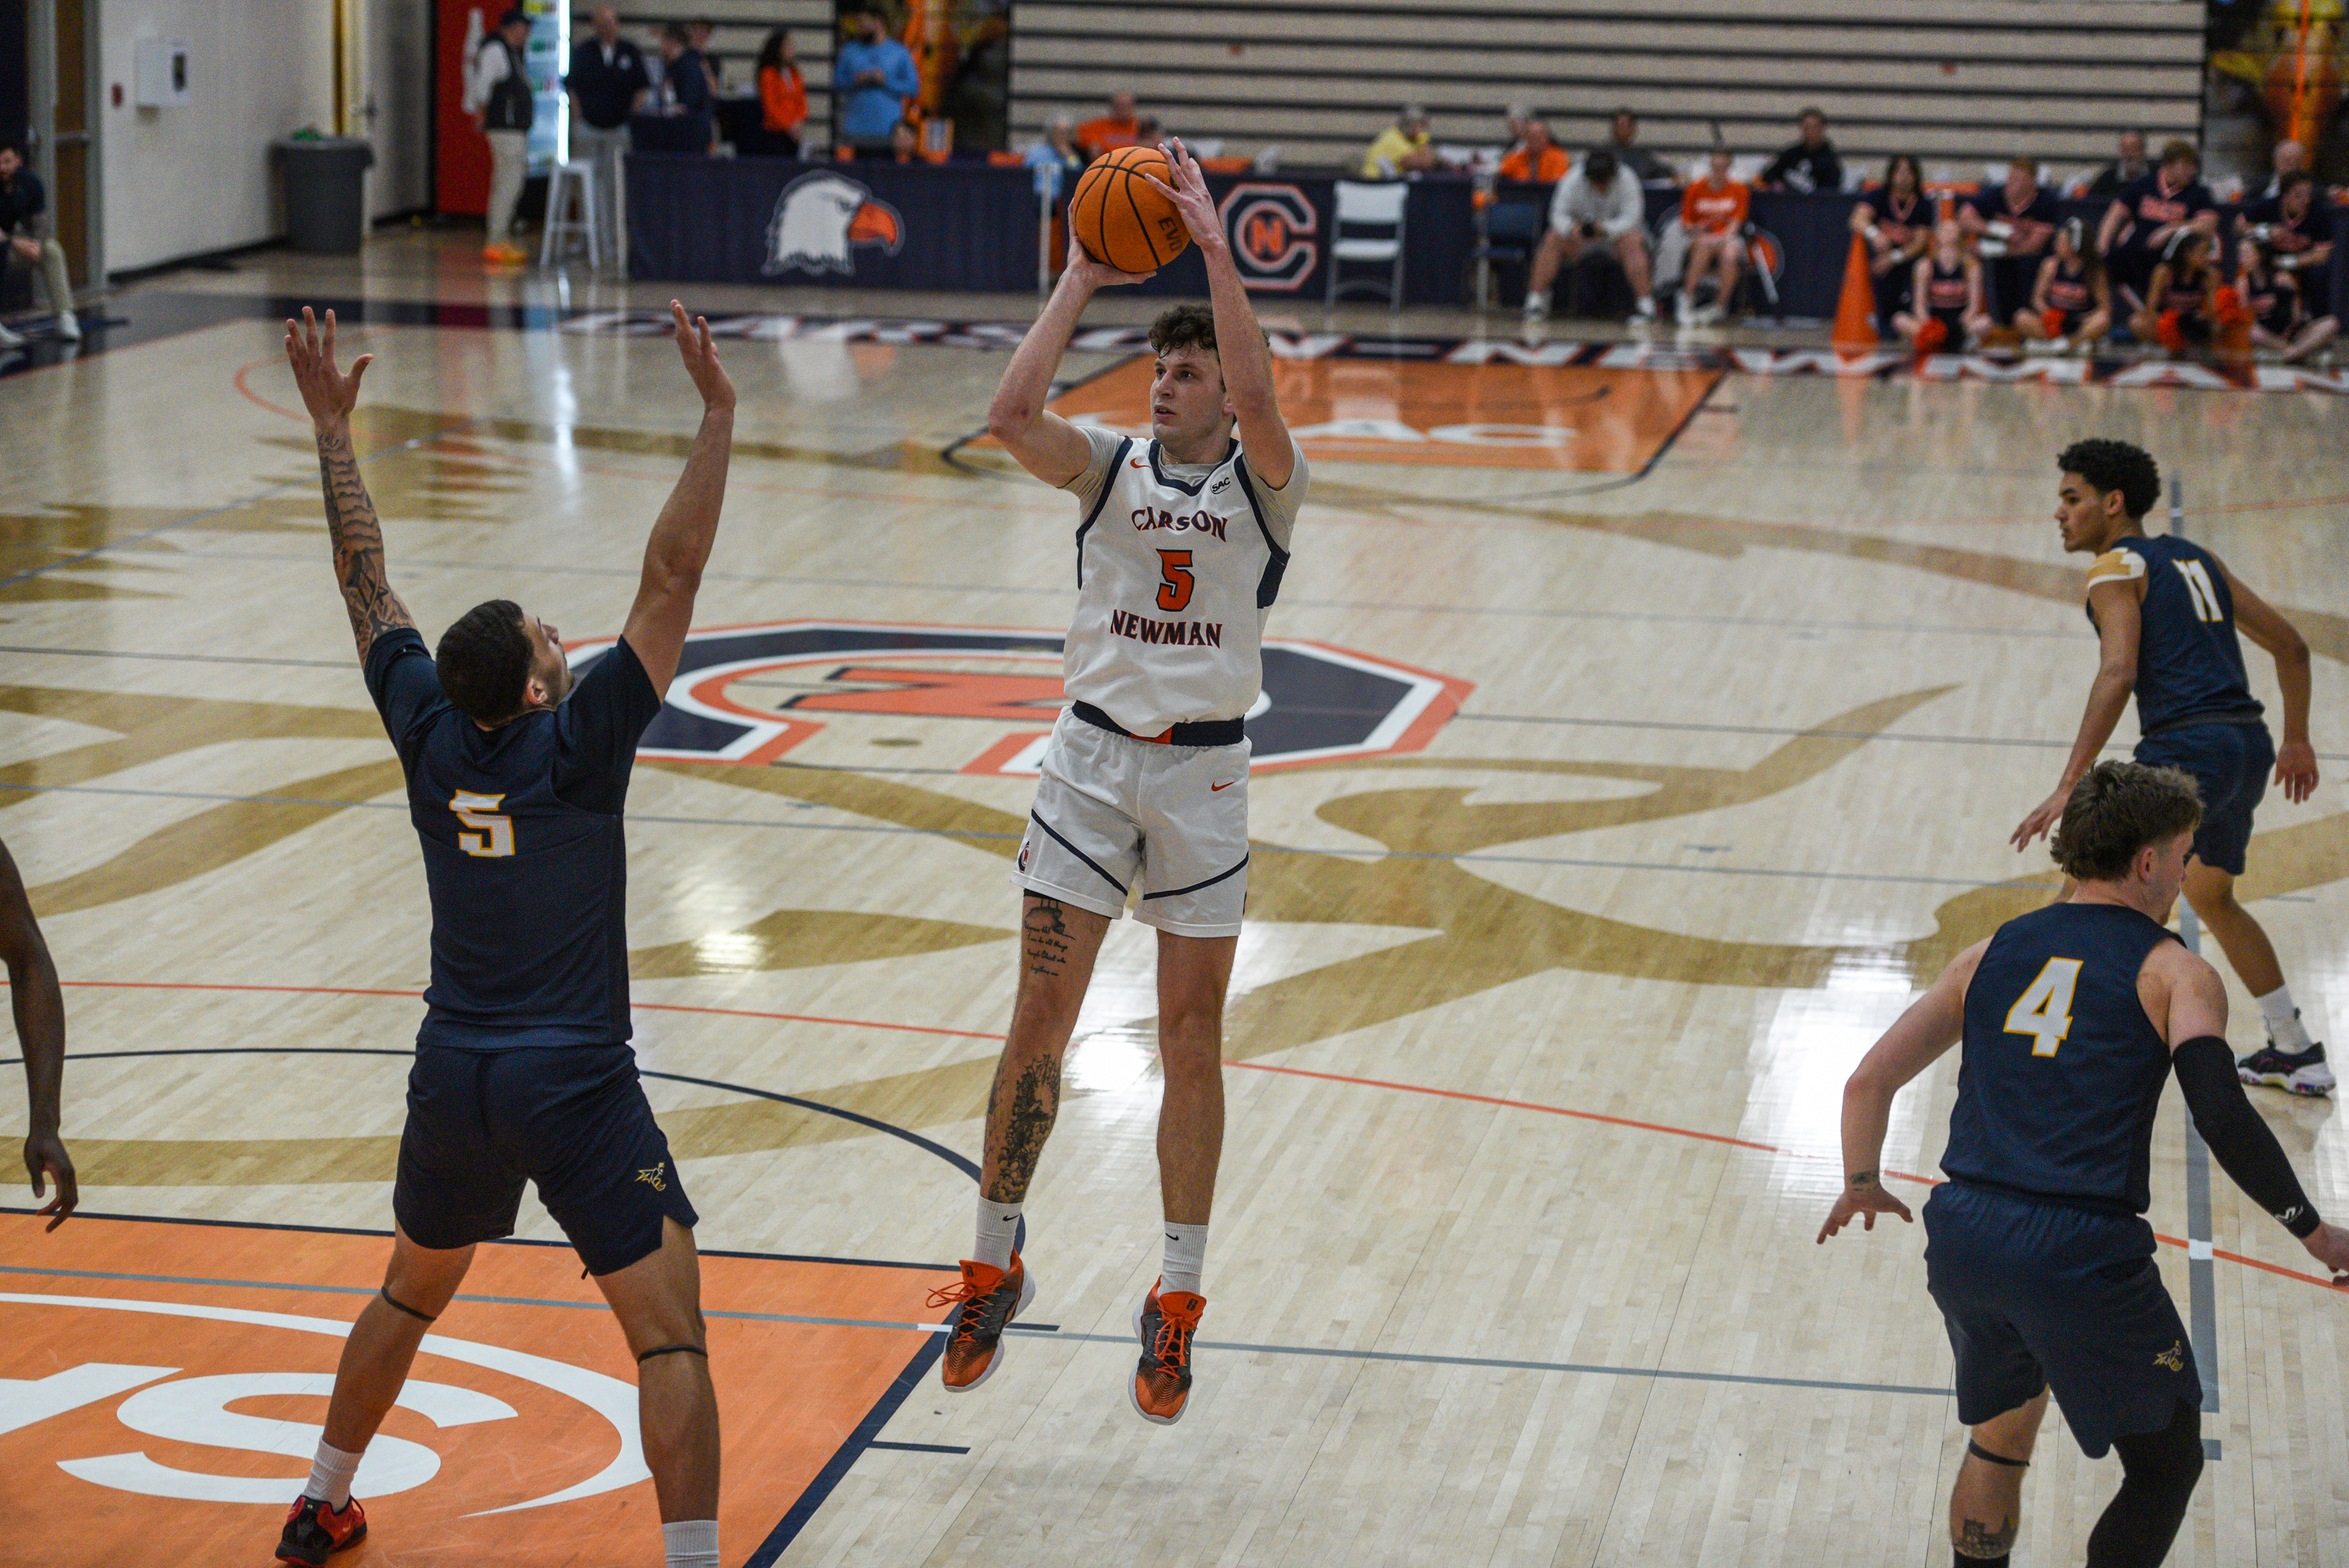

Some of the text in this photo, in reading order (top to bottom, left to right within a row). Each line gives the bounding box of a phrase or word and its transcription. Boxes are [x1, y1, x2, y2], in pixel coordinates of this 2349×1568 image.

[1211, 477, 1232, 493] SAC
[1131, 506, 1229, 543] CARSON
[1156, 548, 1195, 612] 5
[2171, 558, 2224, 622] 11
[1110, 609, 1223, 649] NEWMAN
[448, 788, 516, 858] 5
[2003, 956, 2084, 1057] 4
